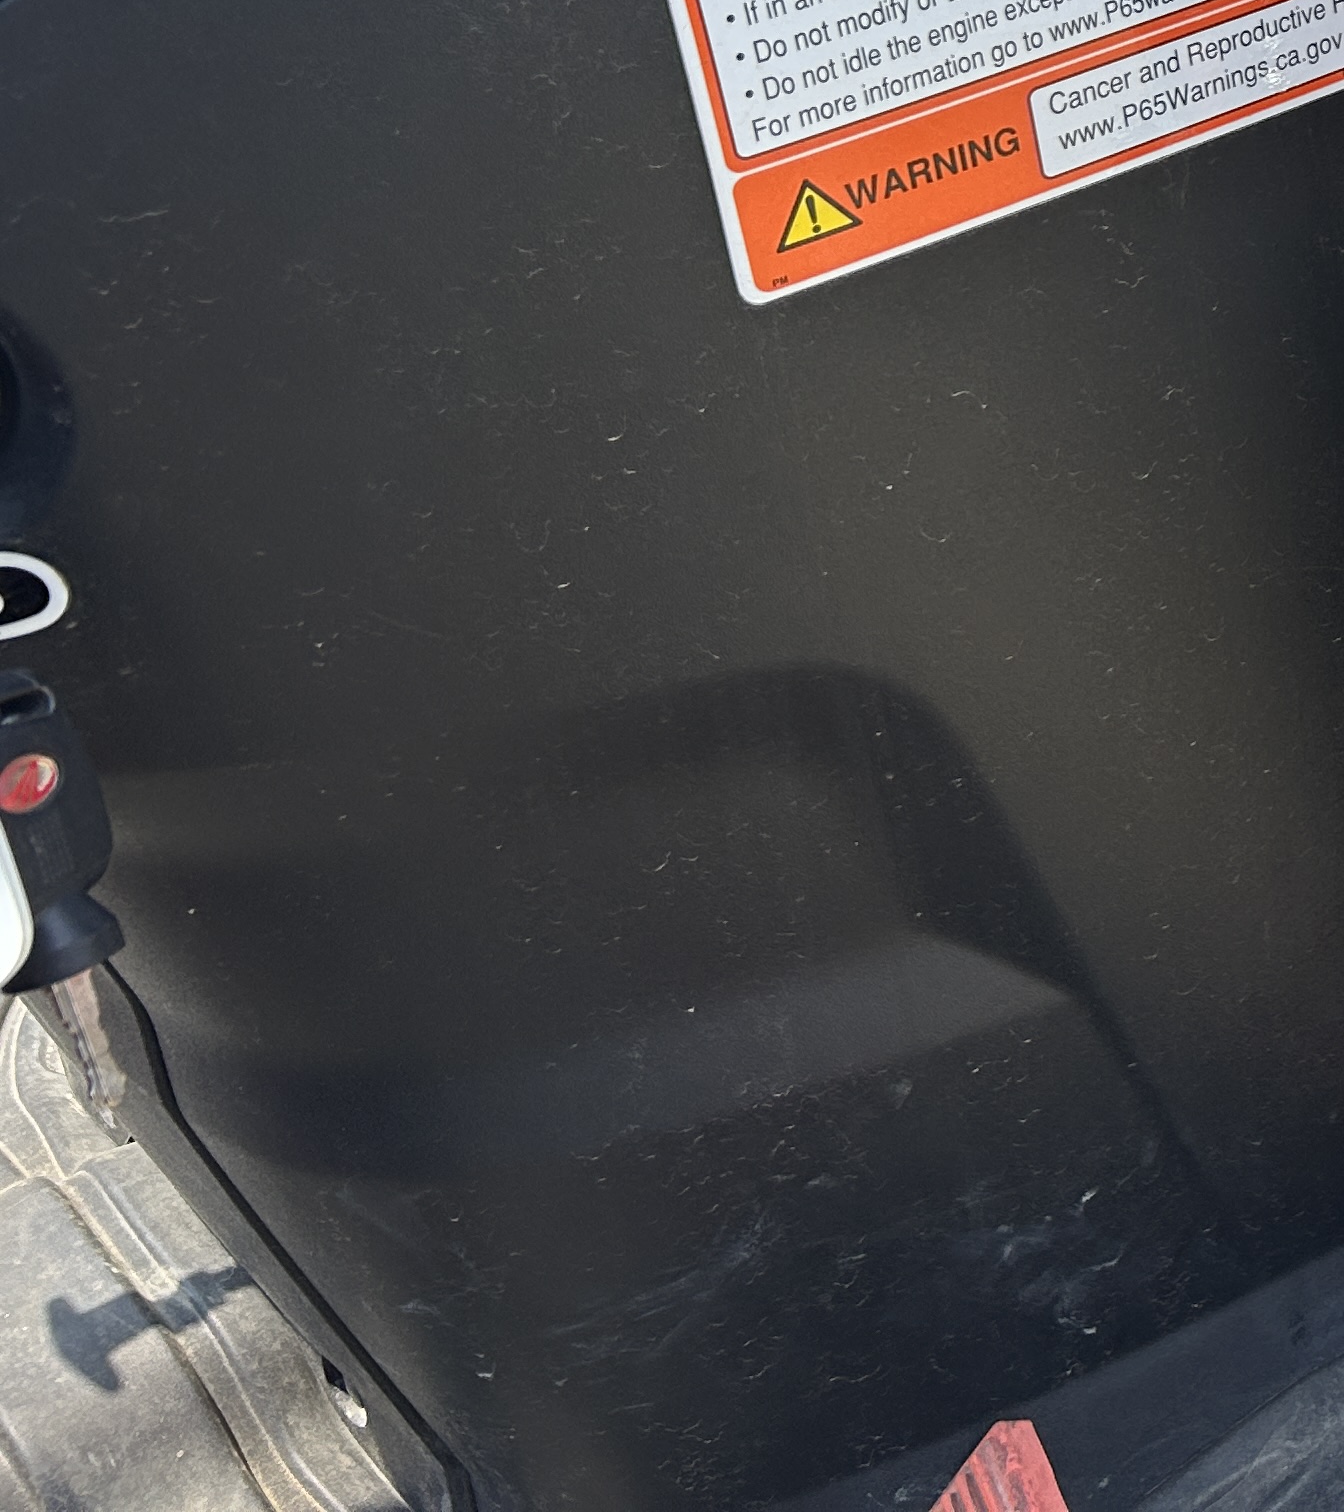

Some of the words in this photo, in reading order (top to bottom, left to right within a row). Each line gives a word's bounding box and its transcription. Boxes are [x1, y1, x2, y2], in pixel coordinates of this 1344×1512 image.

[743, 0, 758, 25] If
[752, 38, 787, 63] Do
[794, 21, 831, 51] not
[762, 76, 795, 100] Do
[802, 58, 838, 88] not
[841, 46, 881, 75] idle
[886, 35, 921, 60] the
[928, 9, 998, 46] engine
[751, 114, 790, 141] For
[798, 94, 857, 127] more
[862, 51, 985, 105] information
[991, 40, 1017, 68] go
[1022, 31, 1043, 51] to
[1049, 71, 1131, 114] Cancer
[1139, 49, 1181, 84] and
[1186, 3, 1326, 66] Reproductive
[844, 127, 1020, 209] WARNING
